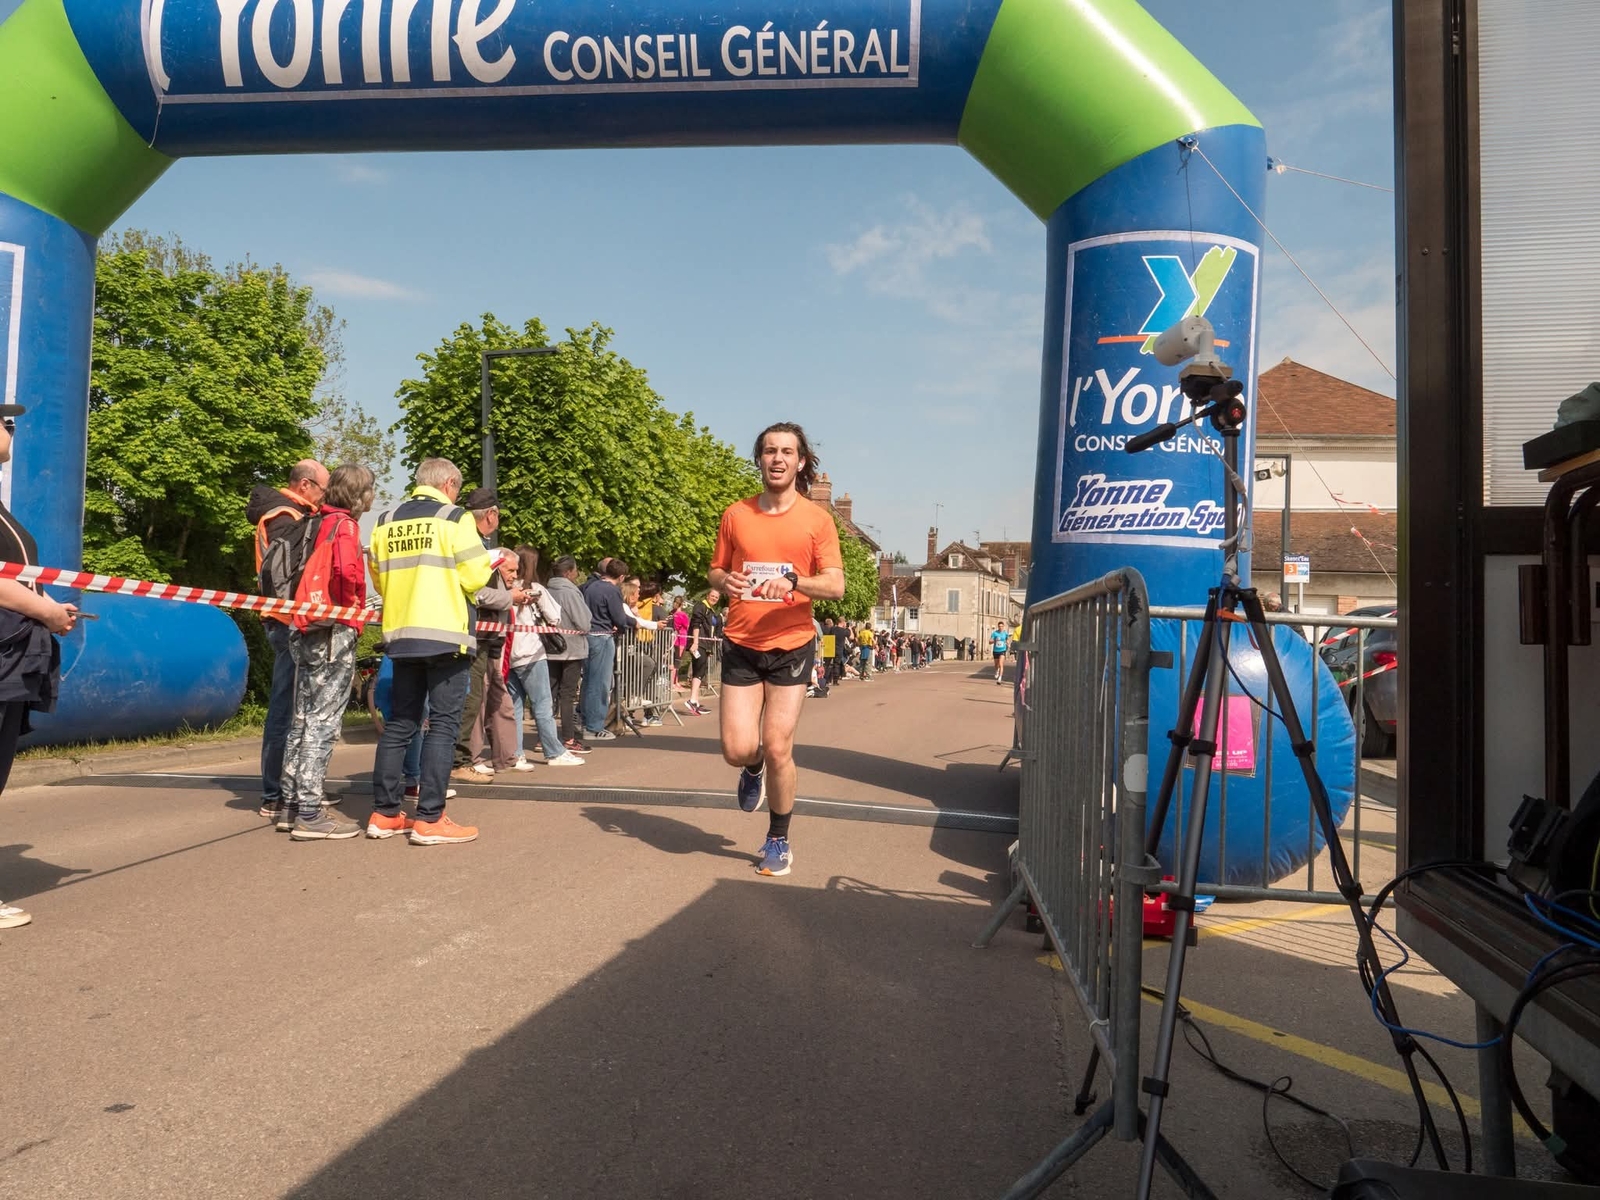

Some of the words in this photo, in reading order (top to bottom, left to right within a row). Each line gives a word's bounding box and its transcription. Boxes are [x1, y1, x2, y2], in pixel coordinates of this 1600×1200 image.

[543, 30, 711, 82] CONSEIL
[721, 19, 910, 77] GÉNÉRAL
[1072, 477, 1168, 509] Yonne
[387, 522, 435, 539] A.S.P.T.T.
[1058, 506, 1185, 533] Génération
[1288, 565, 1294, 573] 3
